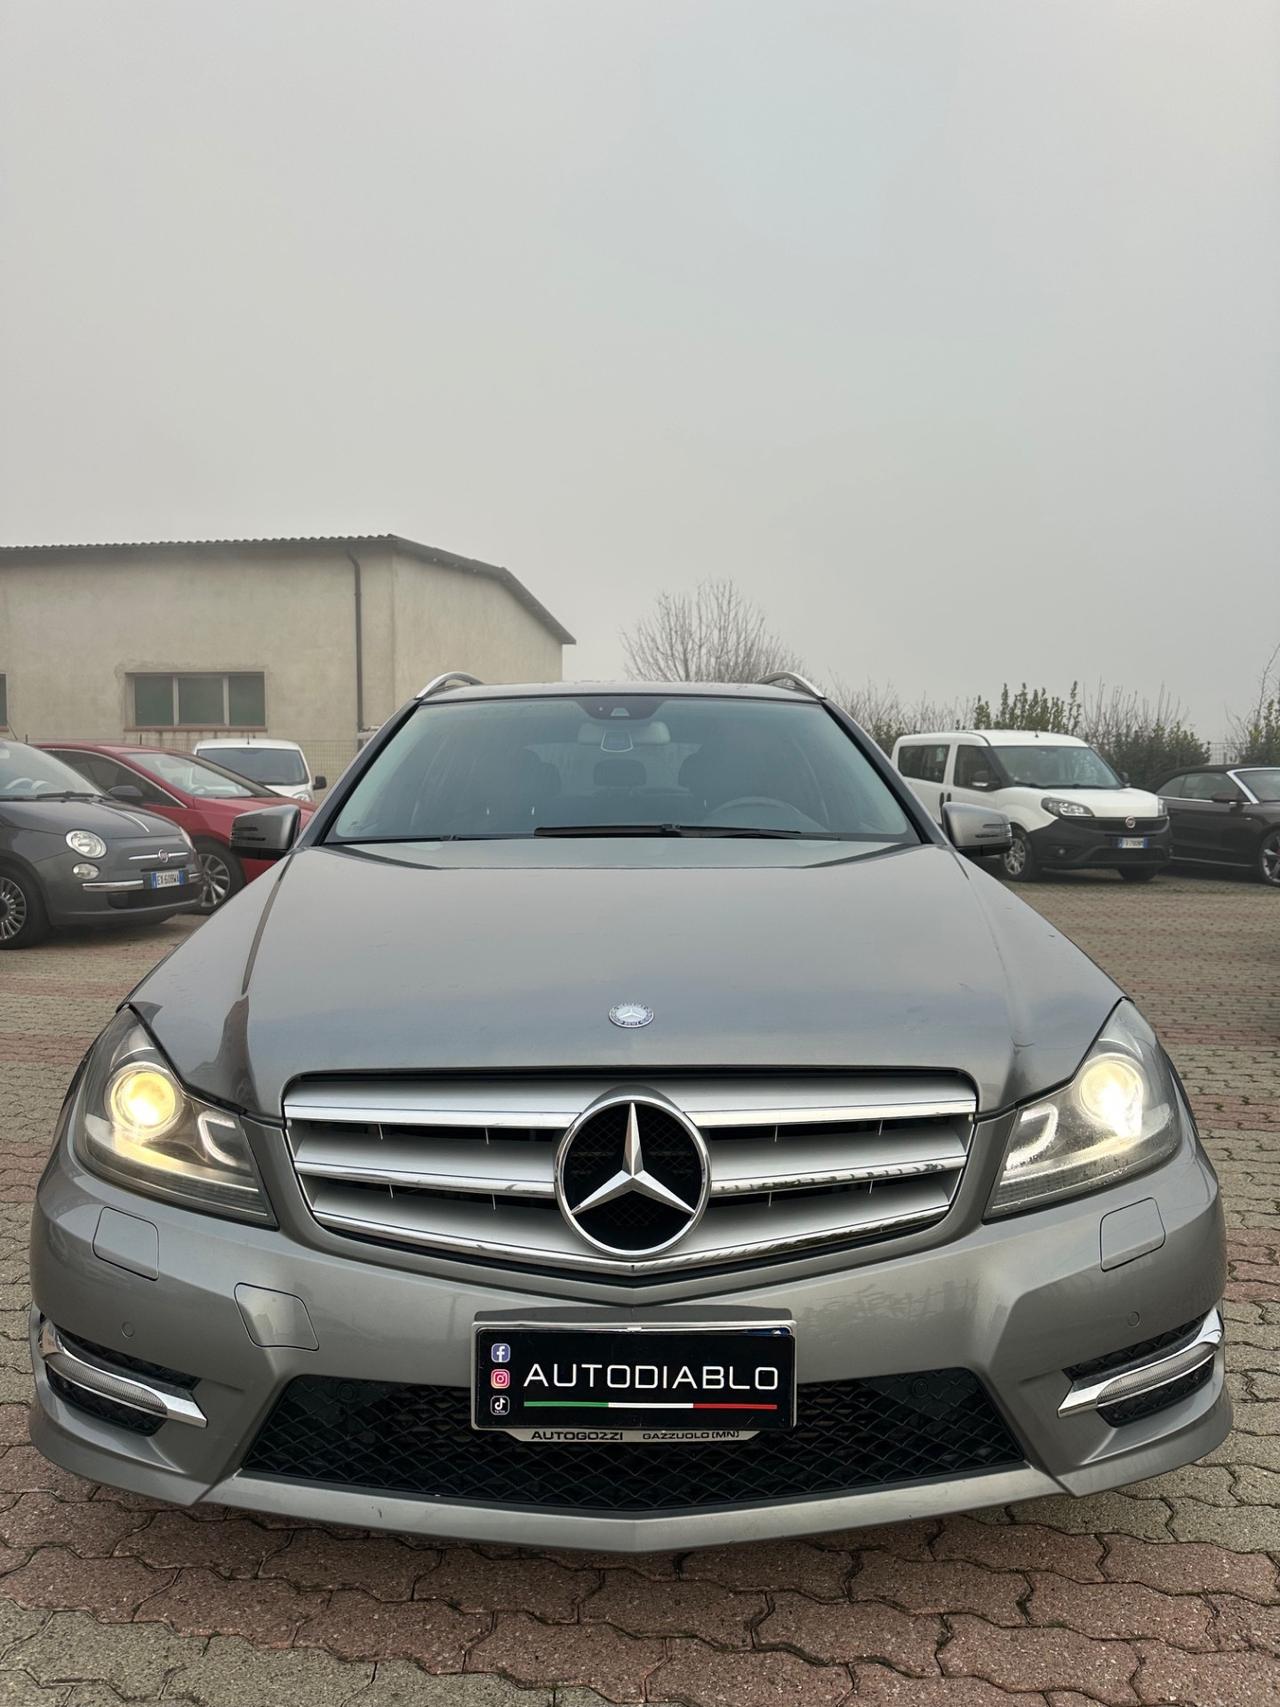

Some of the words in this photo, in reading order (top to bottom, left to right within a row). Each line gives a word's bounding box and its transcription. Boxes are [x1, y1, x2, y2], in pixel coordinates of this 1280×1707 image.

[523, 1363, 778, 1390] AUTODIABLO
[531, 1431, 623, 1441] AUTOGOZZI
[642, 1432, 710, 1440] GAZZUOLO
